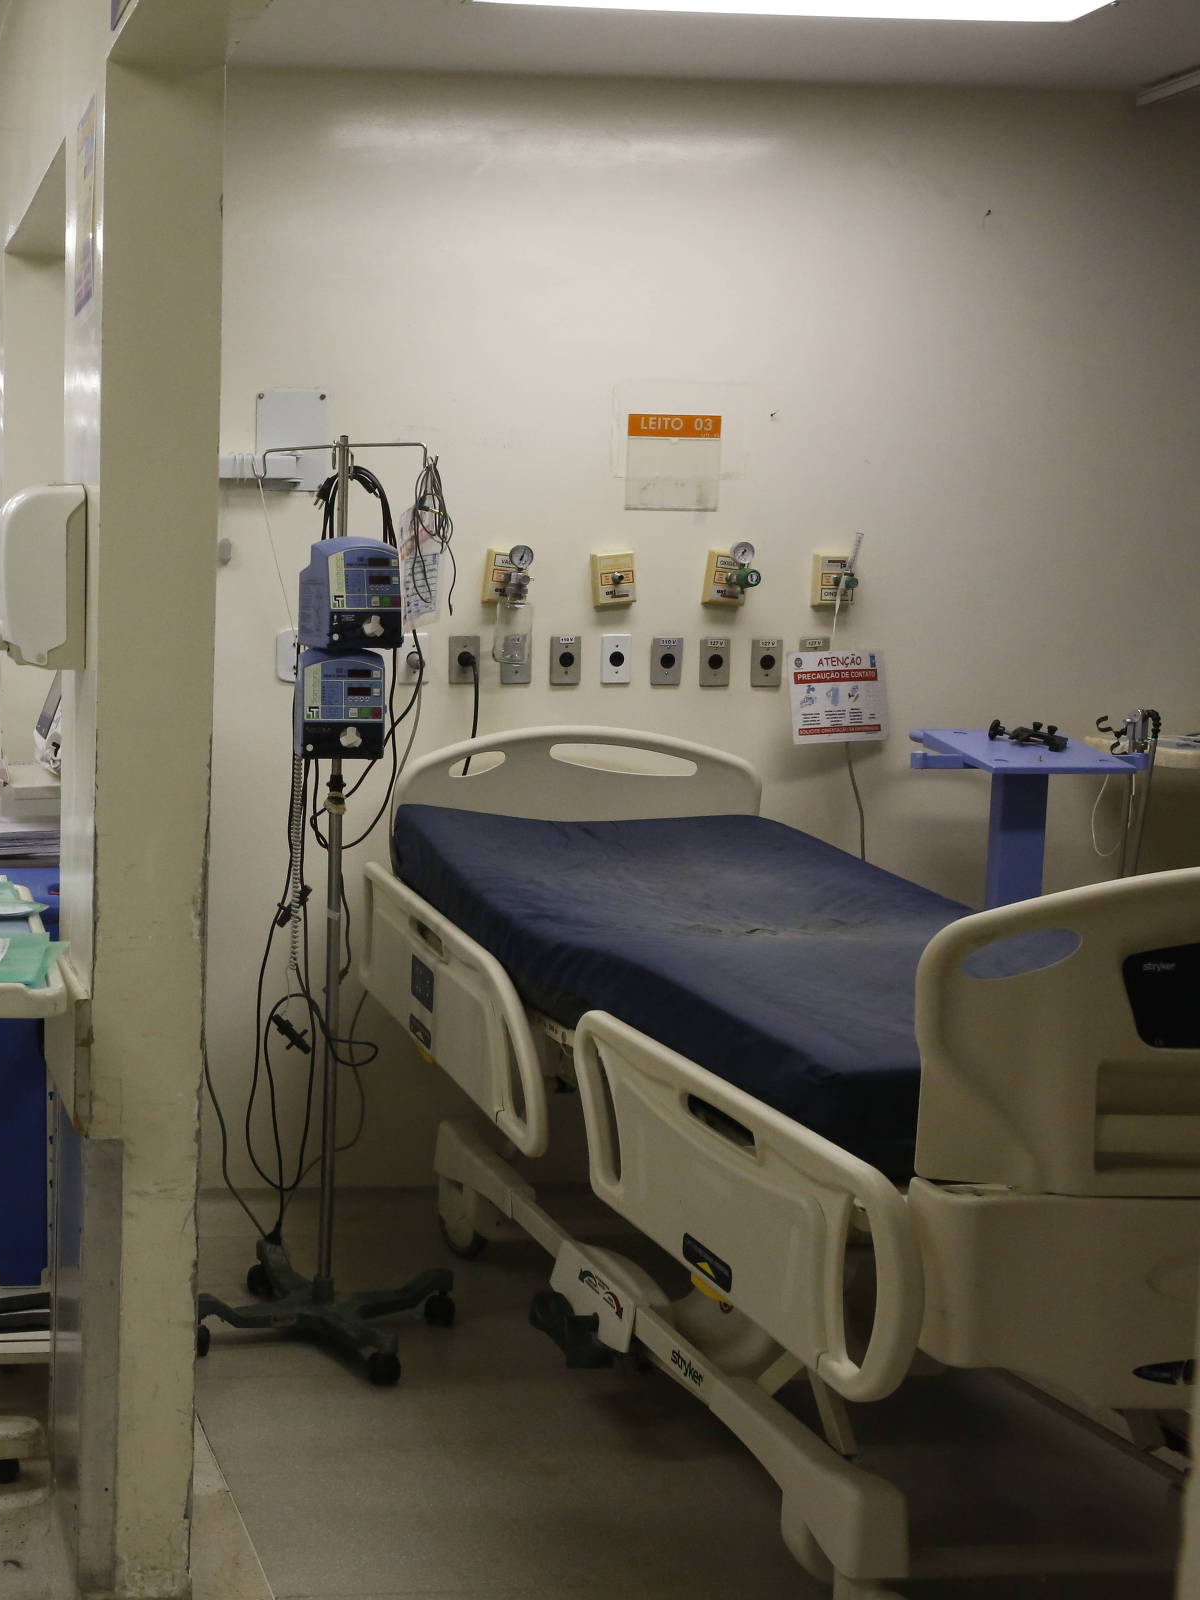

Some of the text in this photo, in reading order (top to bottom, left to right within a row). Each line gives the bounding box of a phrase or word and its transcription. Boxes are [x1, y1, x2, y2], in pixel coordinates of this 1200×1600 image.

[640, 416, 713, 431] LEITO 03
[817, 653, 862, 668] ATENÇÃO
[797, 672, 840, 681] PRECAUÇÃO
[850, 671, 876, 679] CONTATO
[1143, 962, 1176, 972] stryker
[671, 1350, 704, 1387] stryker
